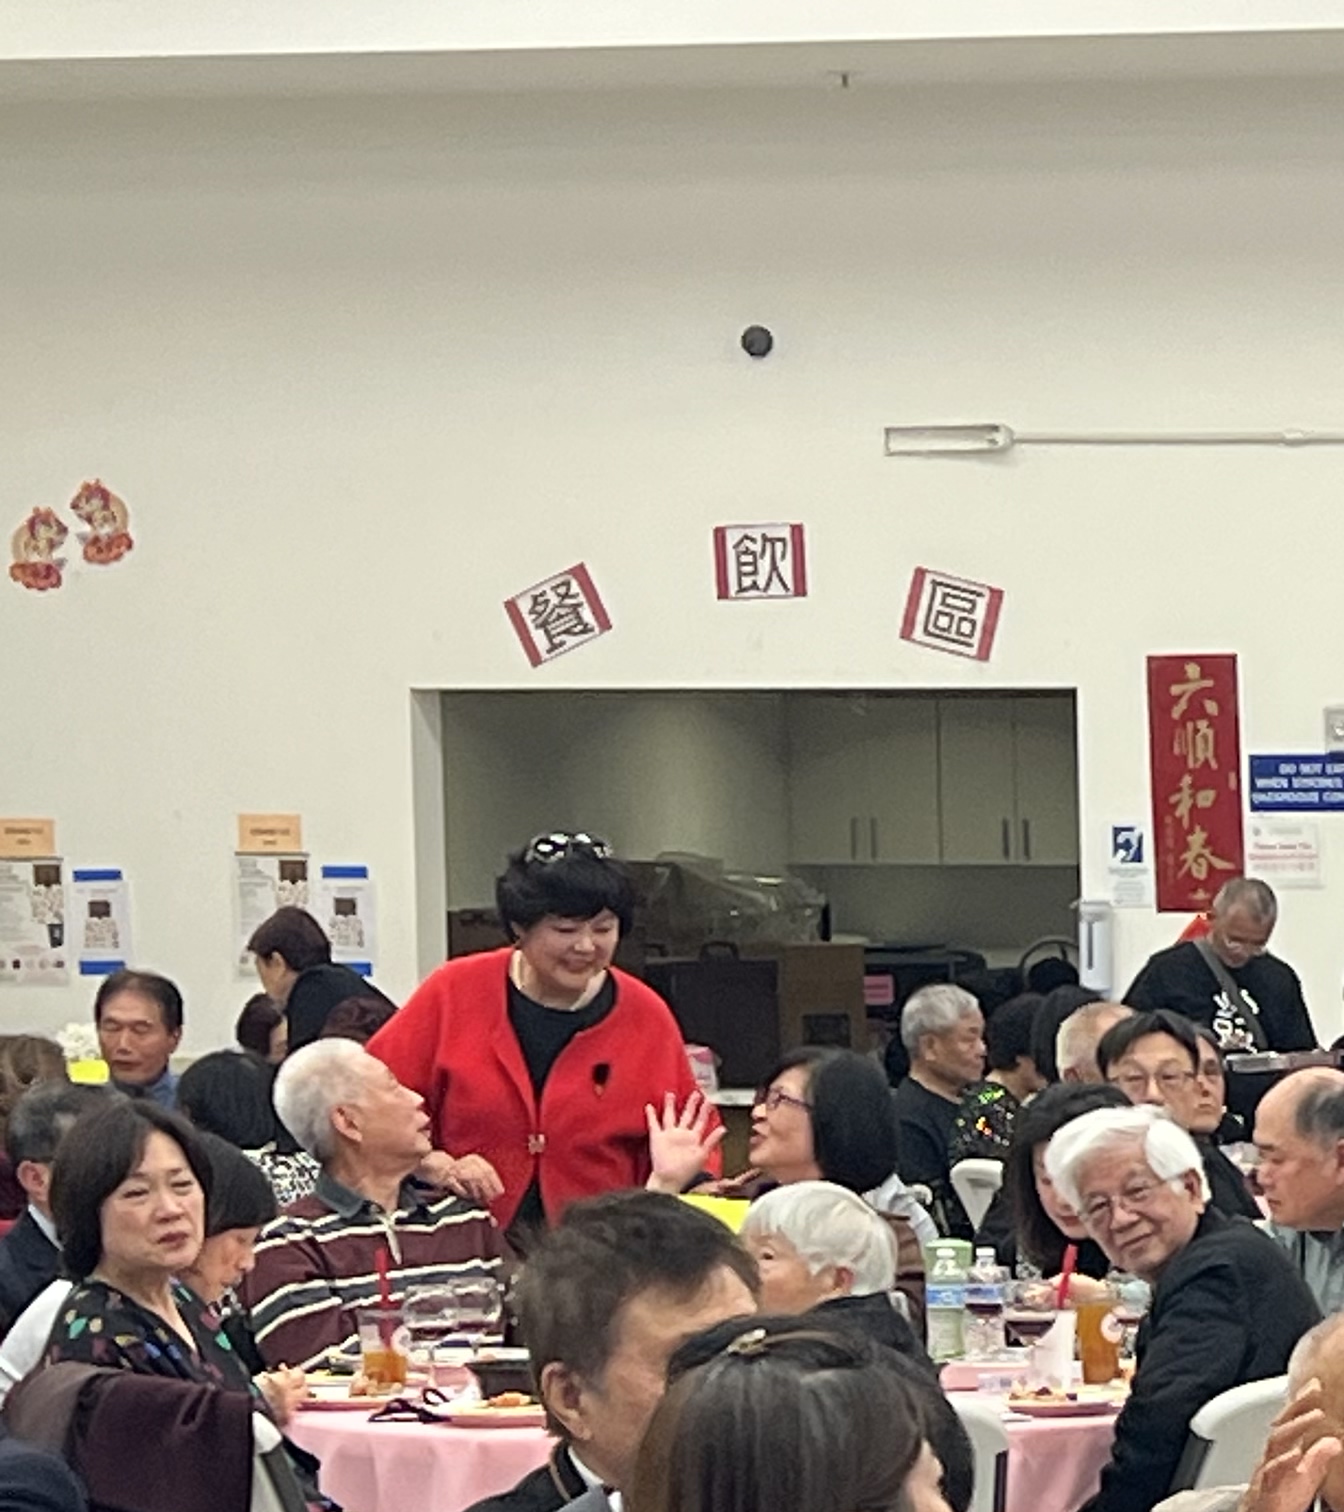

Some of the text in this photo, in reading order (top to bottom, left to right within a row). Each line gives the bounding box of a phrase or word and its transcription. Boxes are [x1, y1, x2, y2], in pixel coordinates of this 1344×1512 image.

[528, 533, 986, 654] 餐 飲 區
